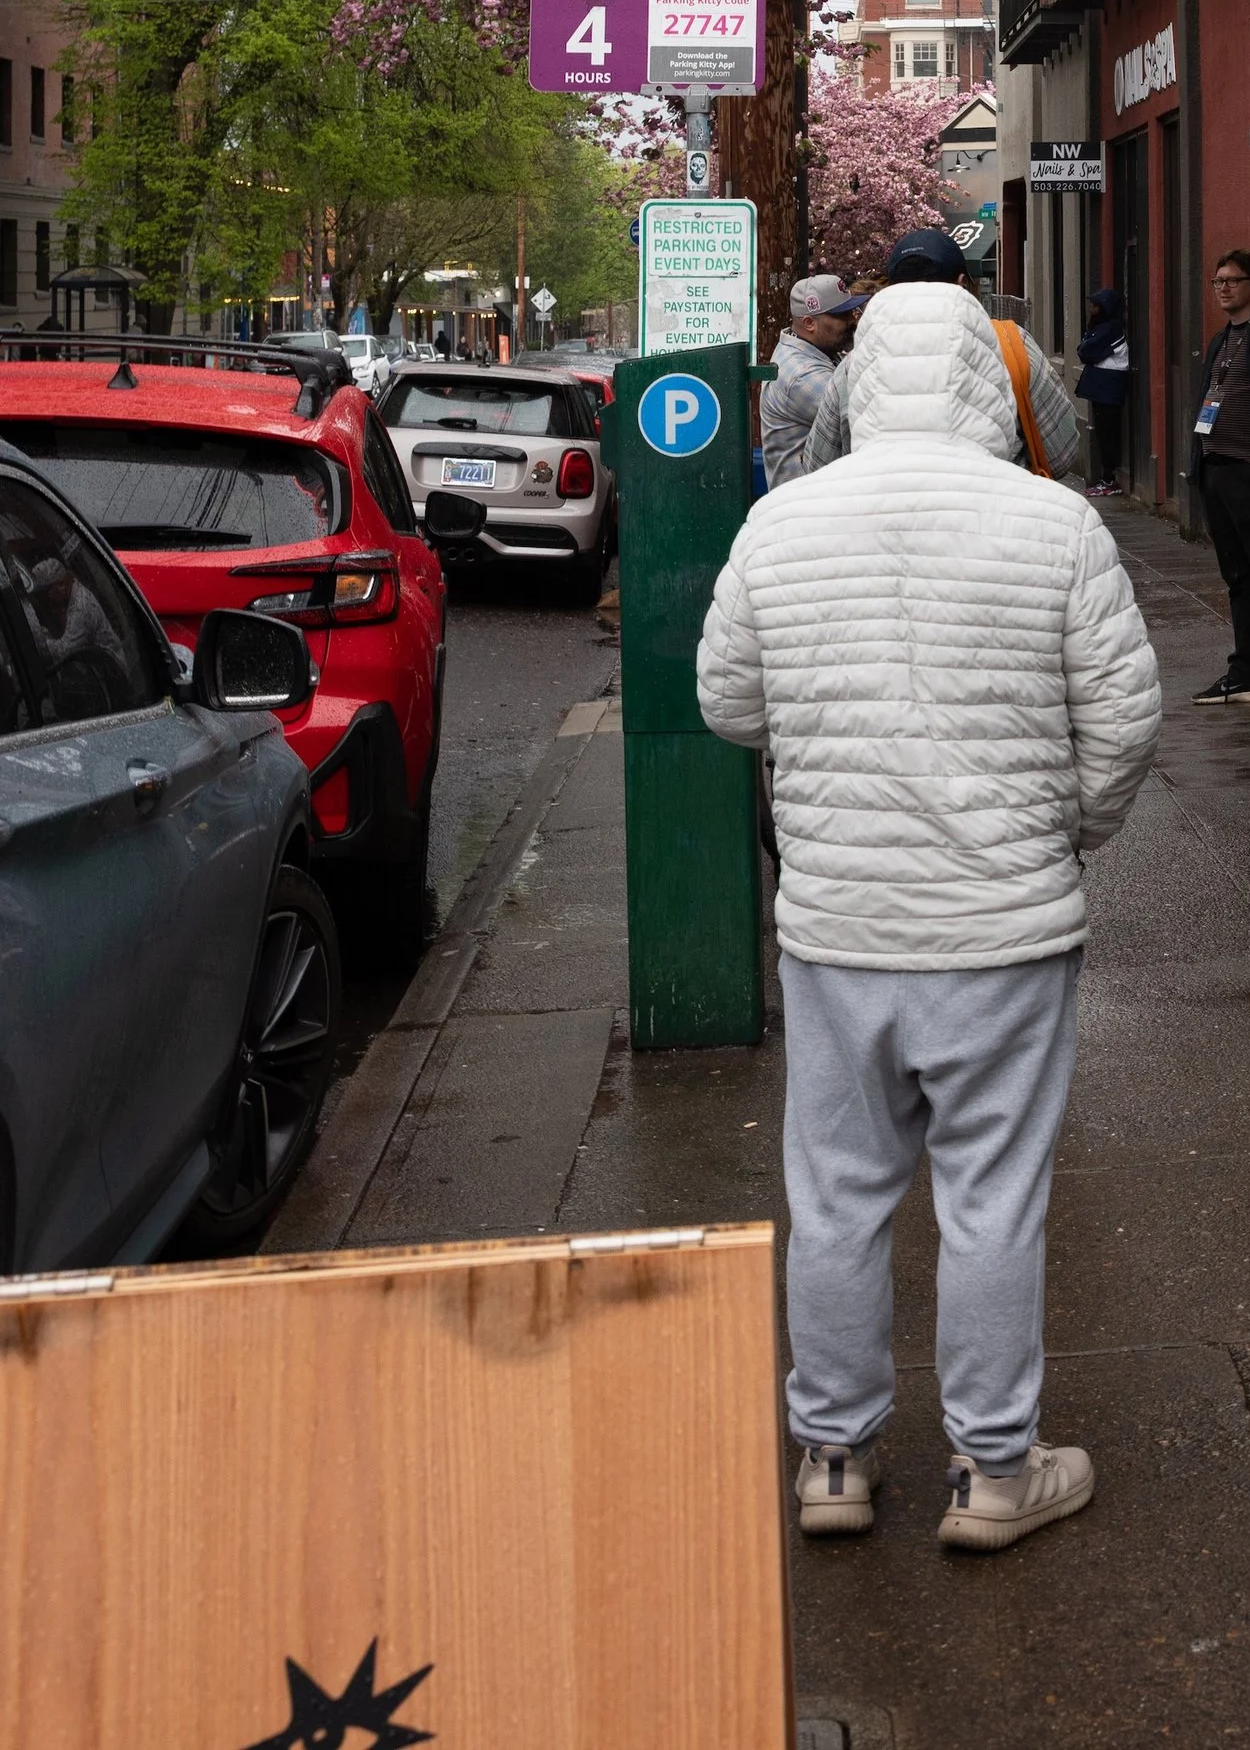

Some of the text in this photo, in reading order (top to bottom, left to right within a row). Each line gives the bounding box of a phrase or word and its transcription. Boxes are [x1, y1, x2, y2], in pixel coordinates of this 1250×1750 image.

[663, 14, 745, 36] 27747
[565, 6, 612, 66] 4
[677, 52, 728, 60] Download the
[670, 60, 736, 69] Parking Kitty App!
[564, 71, 612, 84] HOURS
[674, 70, 731, 78] parkingkitty.com
[1052, 143, 1082, 159] NW
[1032, 162, 1102, 178] Nails & Spa
[1034, 182, 1101, 191] 503.226.7040
[652, 220, 743, 235] RESTRICTED
[654, 239, 741, 253] PARKING ON
[654, 257, 741, 271] EVENT DAYS
[686, 286, 709, 297] SEE
[664, 302, 732, 313] PAYSTATION
[685, 317, 710, 329] FOR
[666, 333, 730, 344] EVENT DAY
[664, 390, 700, 446] P
